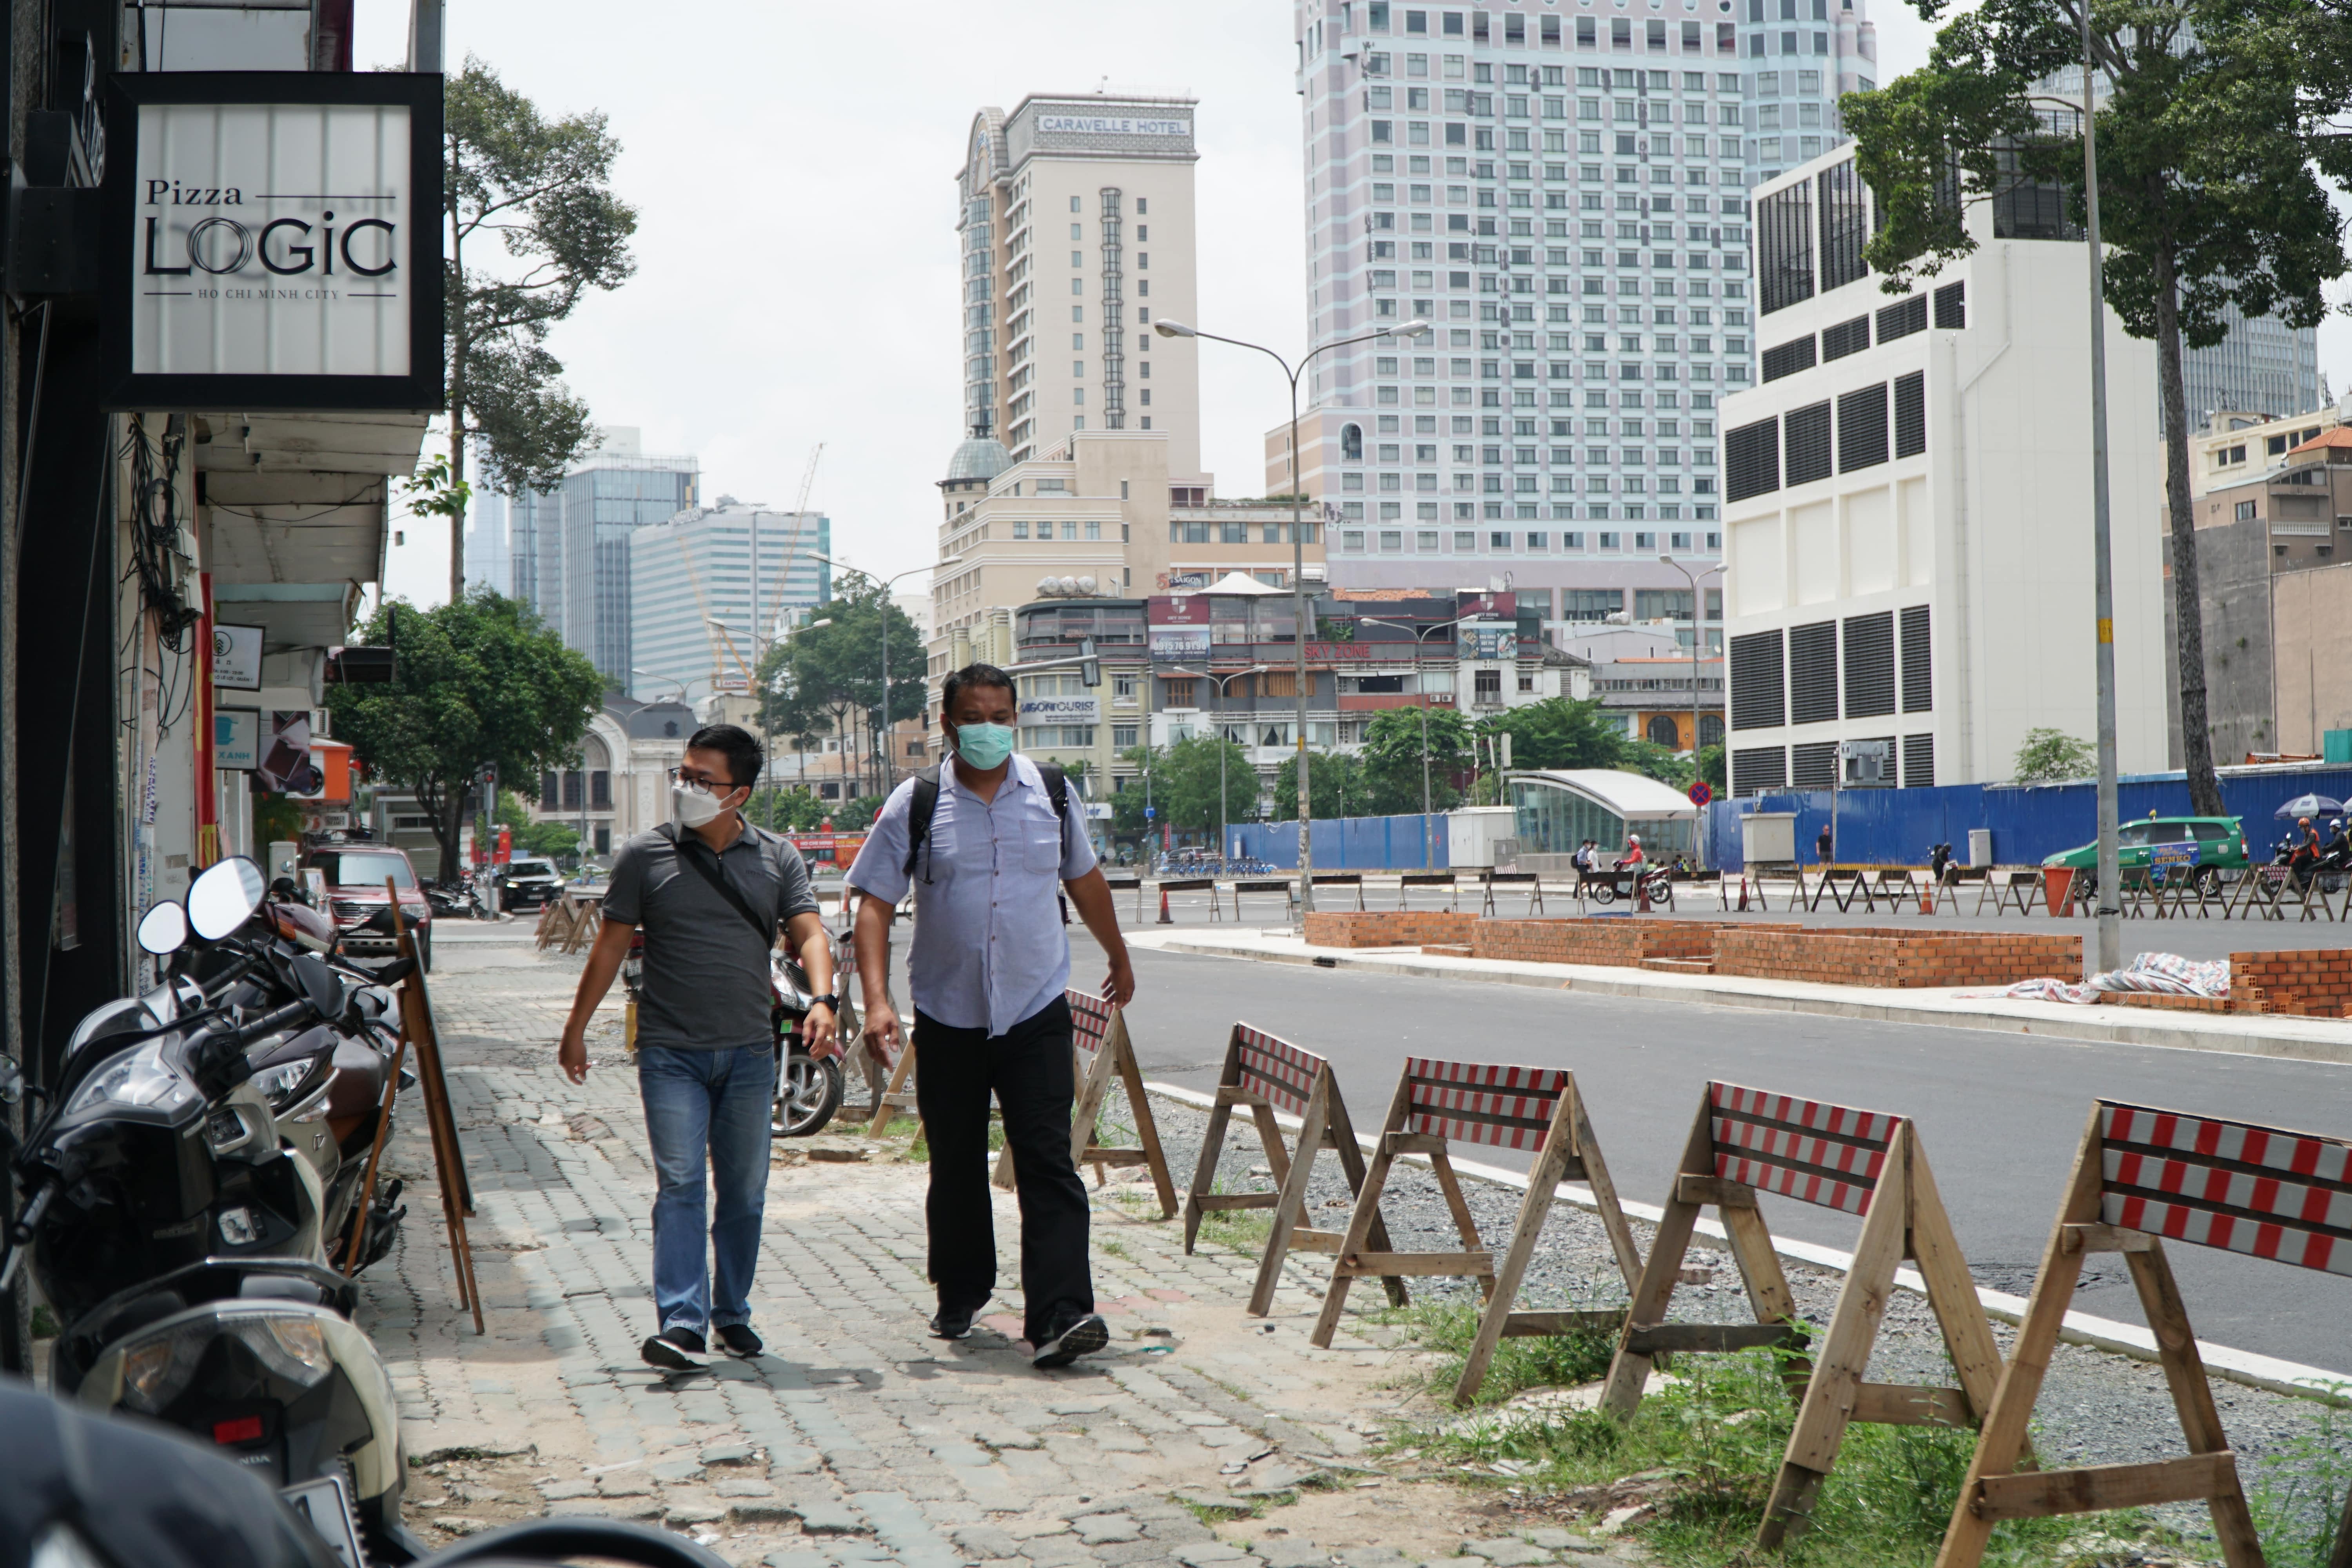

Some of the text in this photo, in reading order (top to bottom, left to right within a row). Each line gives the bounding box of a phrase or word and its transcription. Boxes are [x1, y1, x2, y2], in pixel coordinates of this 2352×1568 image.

[1043, 117, 1186, 134] CARAVELLE HOTEL
[145, 180, 243, 205] Pizza
[198, 289, 339, 300] HO CHI MINH CITY
[1304, 644, 1371, 658] SKY ZONE
[2154, 855, 2191, 864] SENKO
